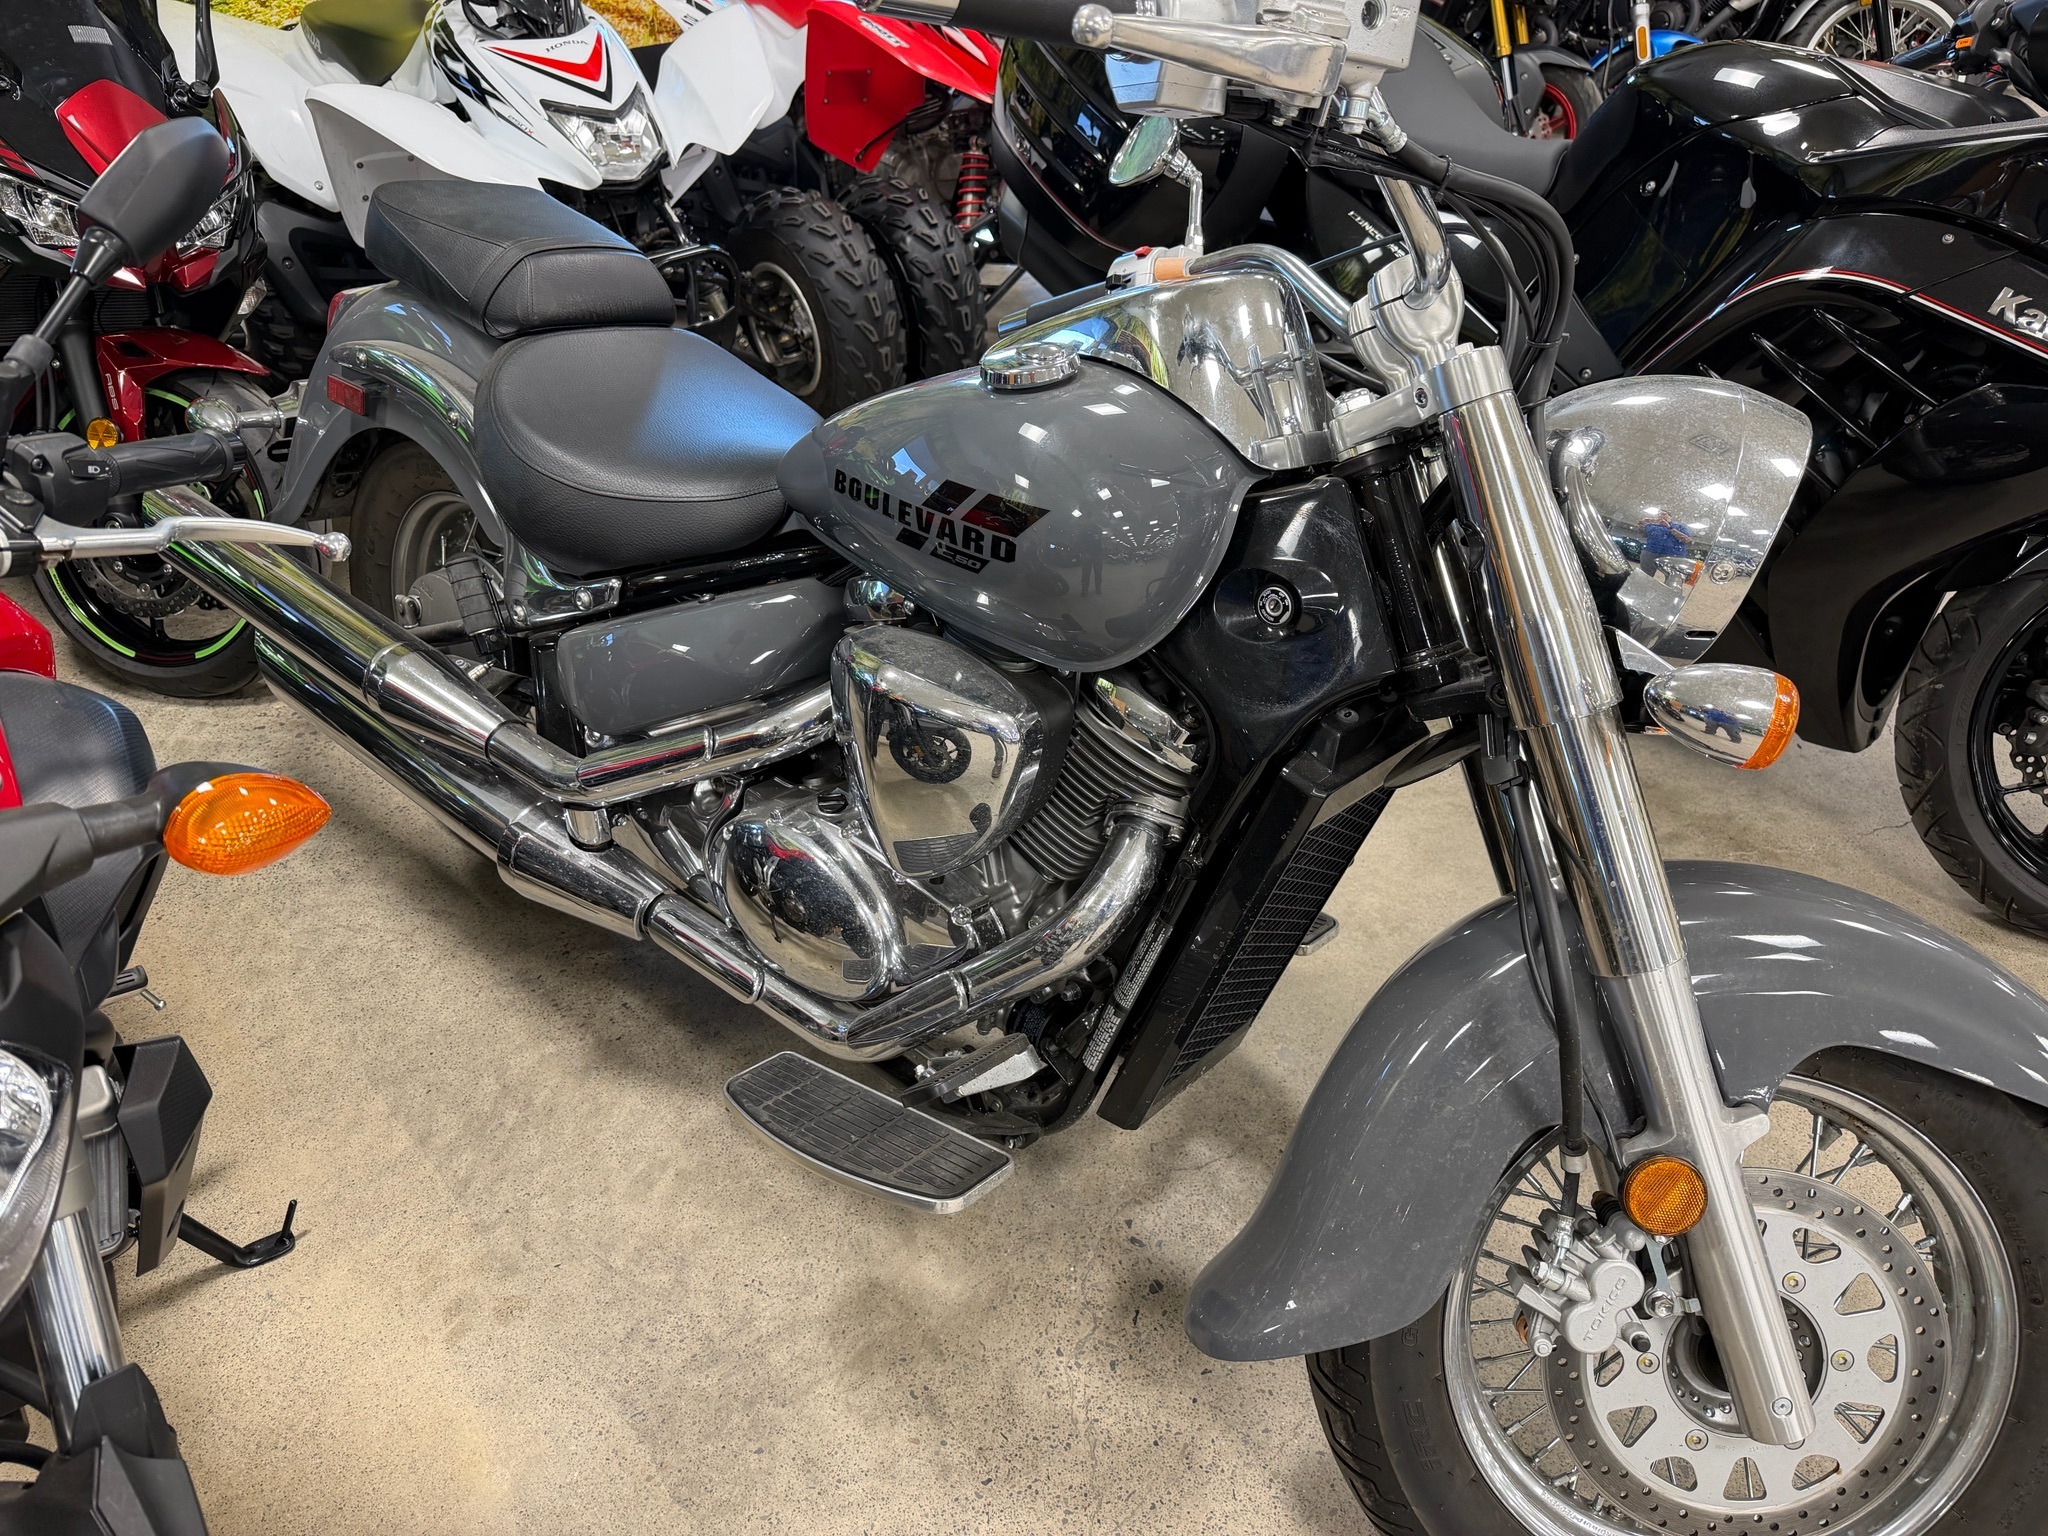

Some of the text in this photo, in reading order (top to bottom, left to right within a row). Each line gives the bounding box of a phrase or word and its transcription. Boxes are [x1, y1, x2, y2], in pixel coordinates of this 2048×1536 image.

[546, 38, 589, 53] HONDA
[105, 373, 119, 410] ABS
[833, 468, 1017, 563] BOULEVARD
[936, 542, 982, 570] C50
[1963, 1153, 1989, 1178] DOT
[1582, 1276, 1627, 1343] TOKICO
